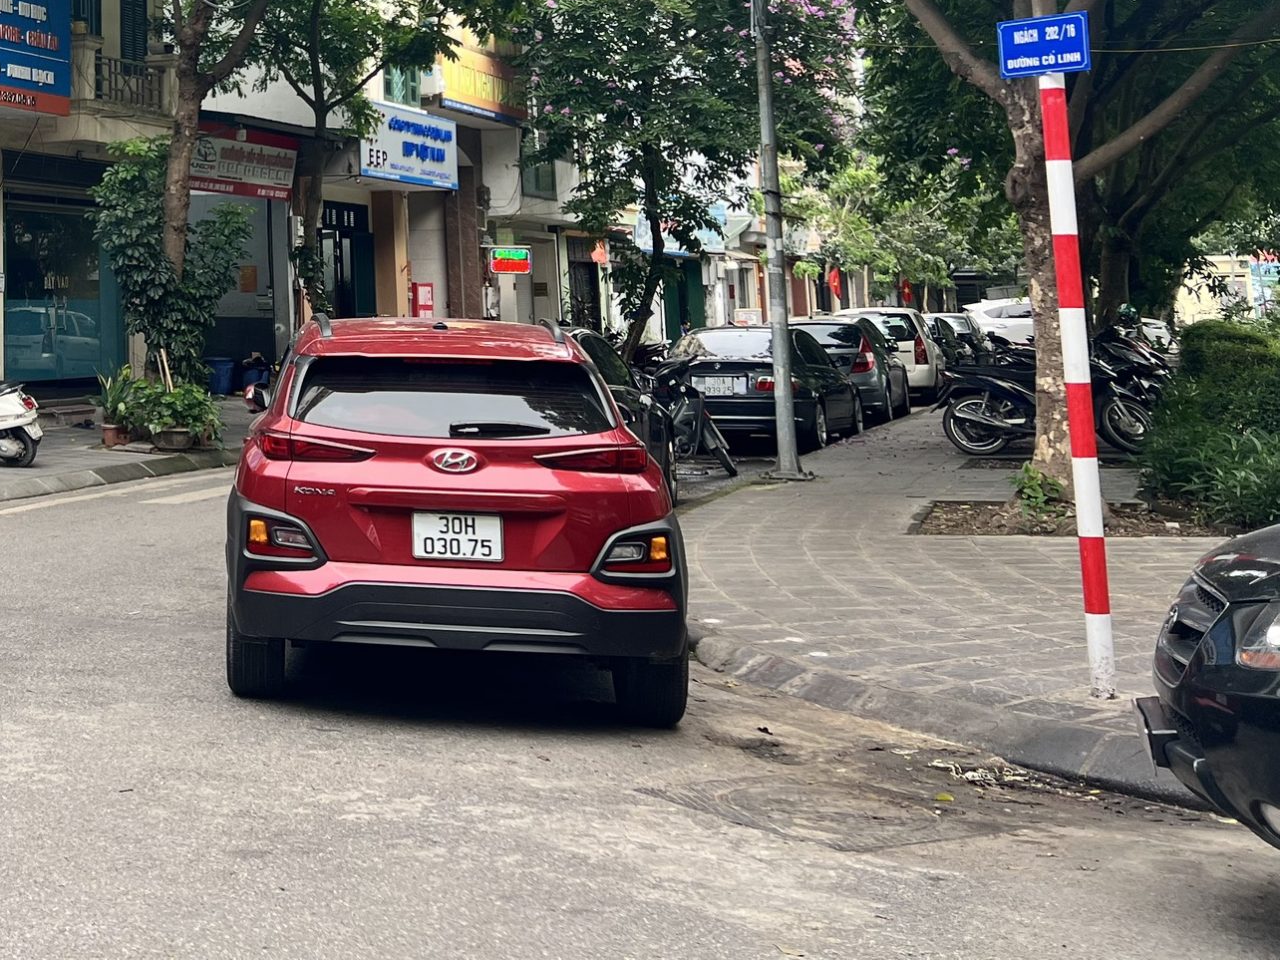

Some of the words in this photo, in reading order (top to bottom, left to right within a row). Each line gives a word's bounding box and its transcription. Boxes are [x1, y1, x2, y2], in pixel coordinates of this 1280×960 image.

[1058, 52, 1081, 64] LINH
[439, 516, 476, 535] 30H
[423, 537, 492, 557] 030.75
